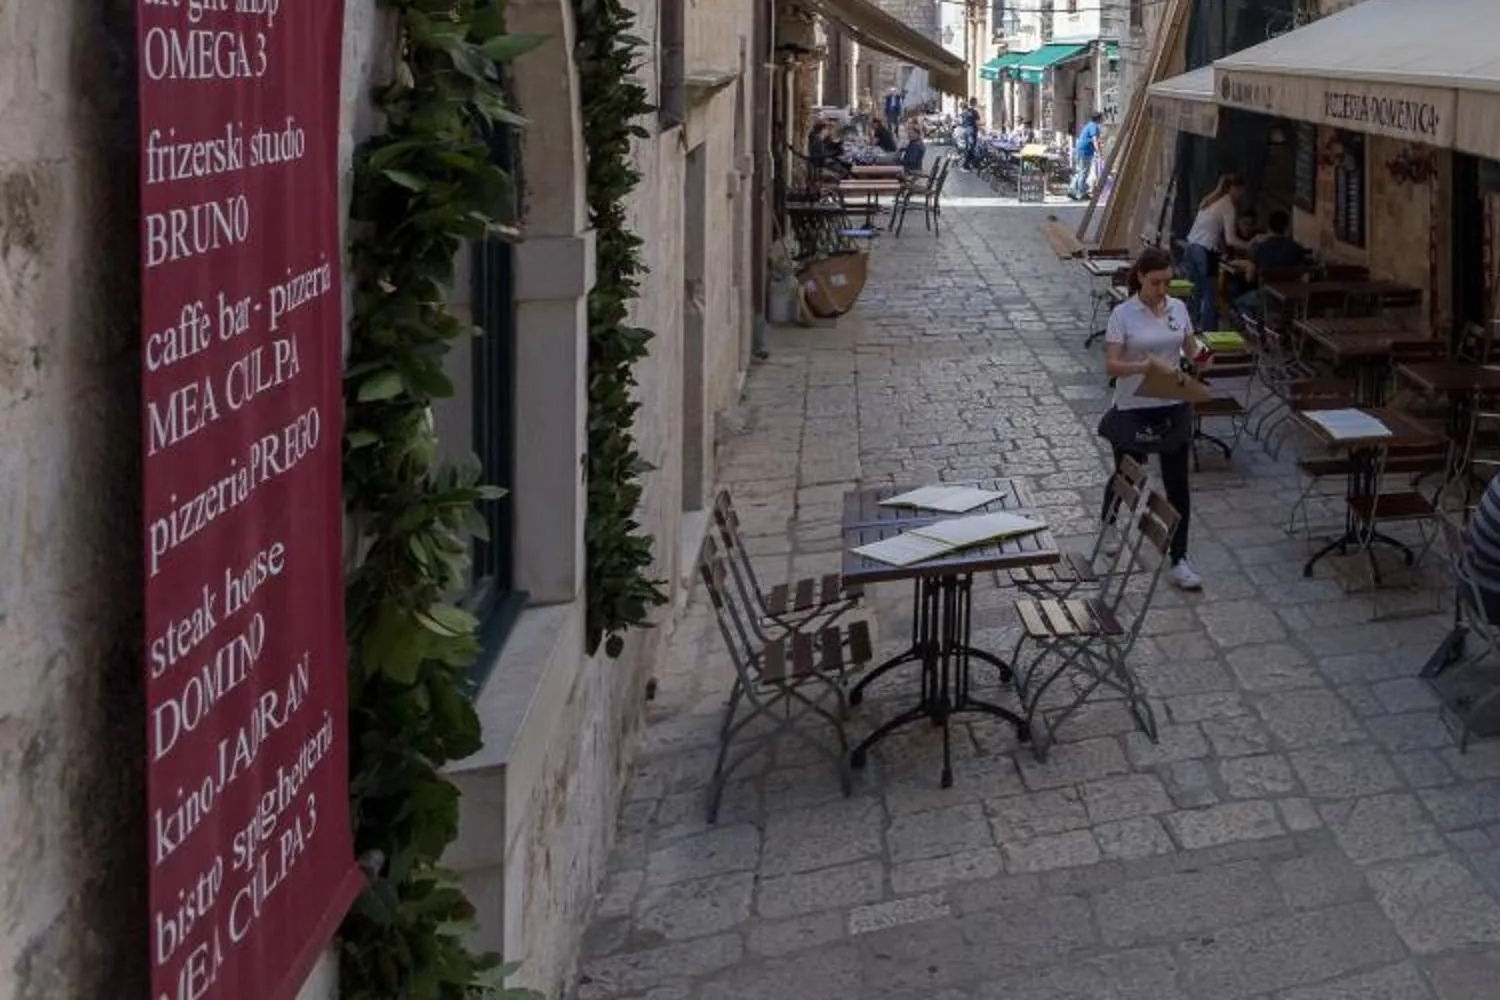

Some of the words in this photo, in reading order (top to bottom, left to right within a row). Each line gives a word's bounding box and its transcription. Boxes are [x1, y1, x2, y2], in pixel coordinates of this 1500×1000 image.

[144, 27, 252, 80] OMEGA
[255, 32, 268, 78] 3
[146, 121, 245, 184] frizerski
[249, 115, 305, 167] studio
[145, 194, 250, 267] BRUNO
[147, 299, 211, 371] caffe
[269, 252, 331, 333] pizzeria
[148, 374, 220, 457] MEA
[226, 334, 301, 410] CULPA
[149, 457, 248, 578] pizzeria
[249, 406, 321, 497] PREGO
[151, 583, 217, 680] steak
[223, 541, 286, 619] house
[152, 612, 266, 762] DOMINO
[153, 776, 213, 866] kino
[215, 653, 312, 795] JADRAN
[306, 791, 318, 842] 3
[155, 854, 224, 967] bistro
